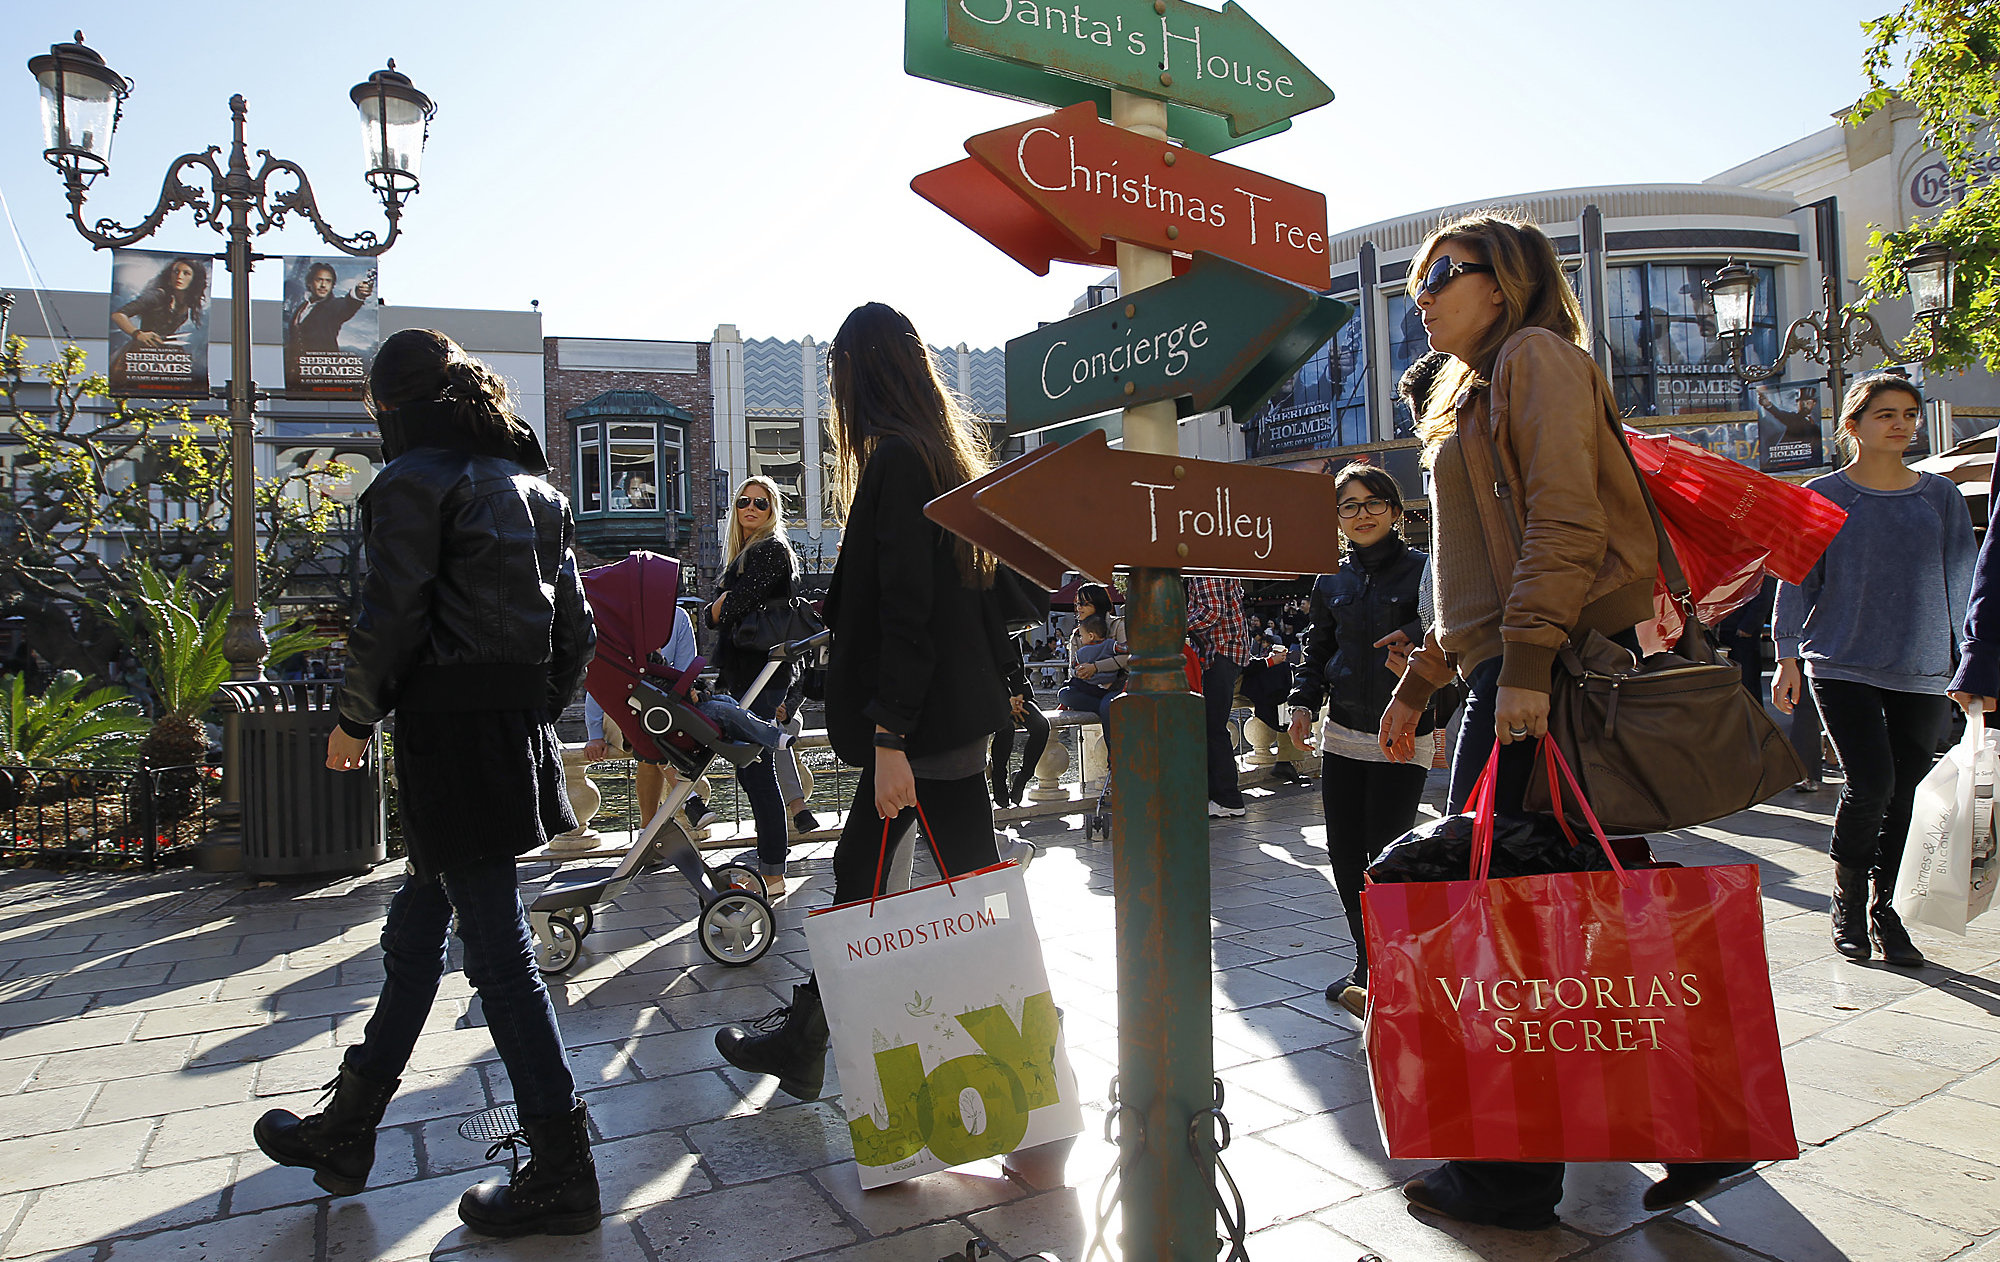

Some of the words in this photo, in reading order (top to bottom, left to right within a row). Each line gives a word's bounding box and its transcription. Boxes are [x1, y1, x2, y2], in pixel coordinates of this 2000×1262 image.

[1159, 15, 1295, 98] House
[1017, 127, 1226, 228] Christmas
[1233, 187, 1325, 255] Tree
[125, 352, 192, 363] SHERLOCK
[125, 361, 192, 374] HOLMES
[299, 356, 363, 365] SHERLOCK
[299, 365, 364, 376] HOLMES
[1041, 320, 1209, 400] Concierge
[1657, 379, 1743, 395] HOLMES
[1264, 402, 1330, 424] SHERLOCK
[1270, 416, 1332, 441] HOLMES
[1769, 443, 1812, 451] SHERLOCK
[1770, 448, 1812, 458] HOLMES
[1729, 483, 1754, 519] ICTORIA'S
[1130, 481, 1273, 560] Trolley
[1910, 855, 1933, 897] Barnes
[1926, 807, 1952, 843] Nobl
[846, 907, 997, 962] NORDSTROM
[1435, 970, 1703, 1013] VICTORIA'S
[1494, 1017, 1666, 1054] SECRET
